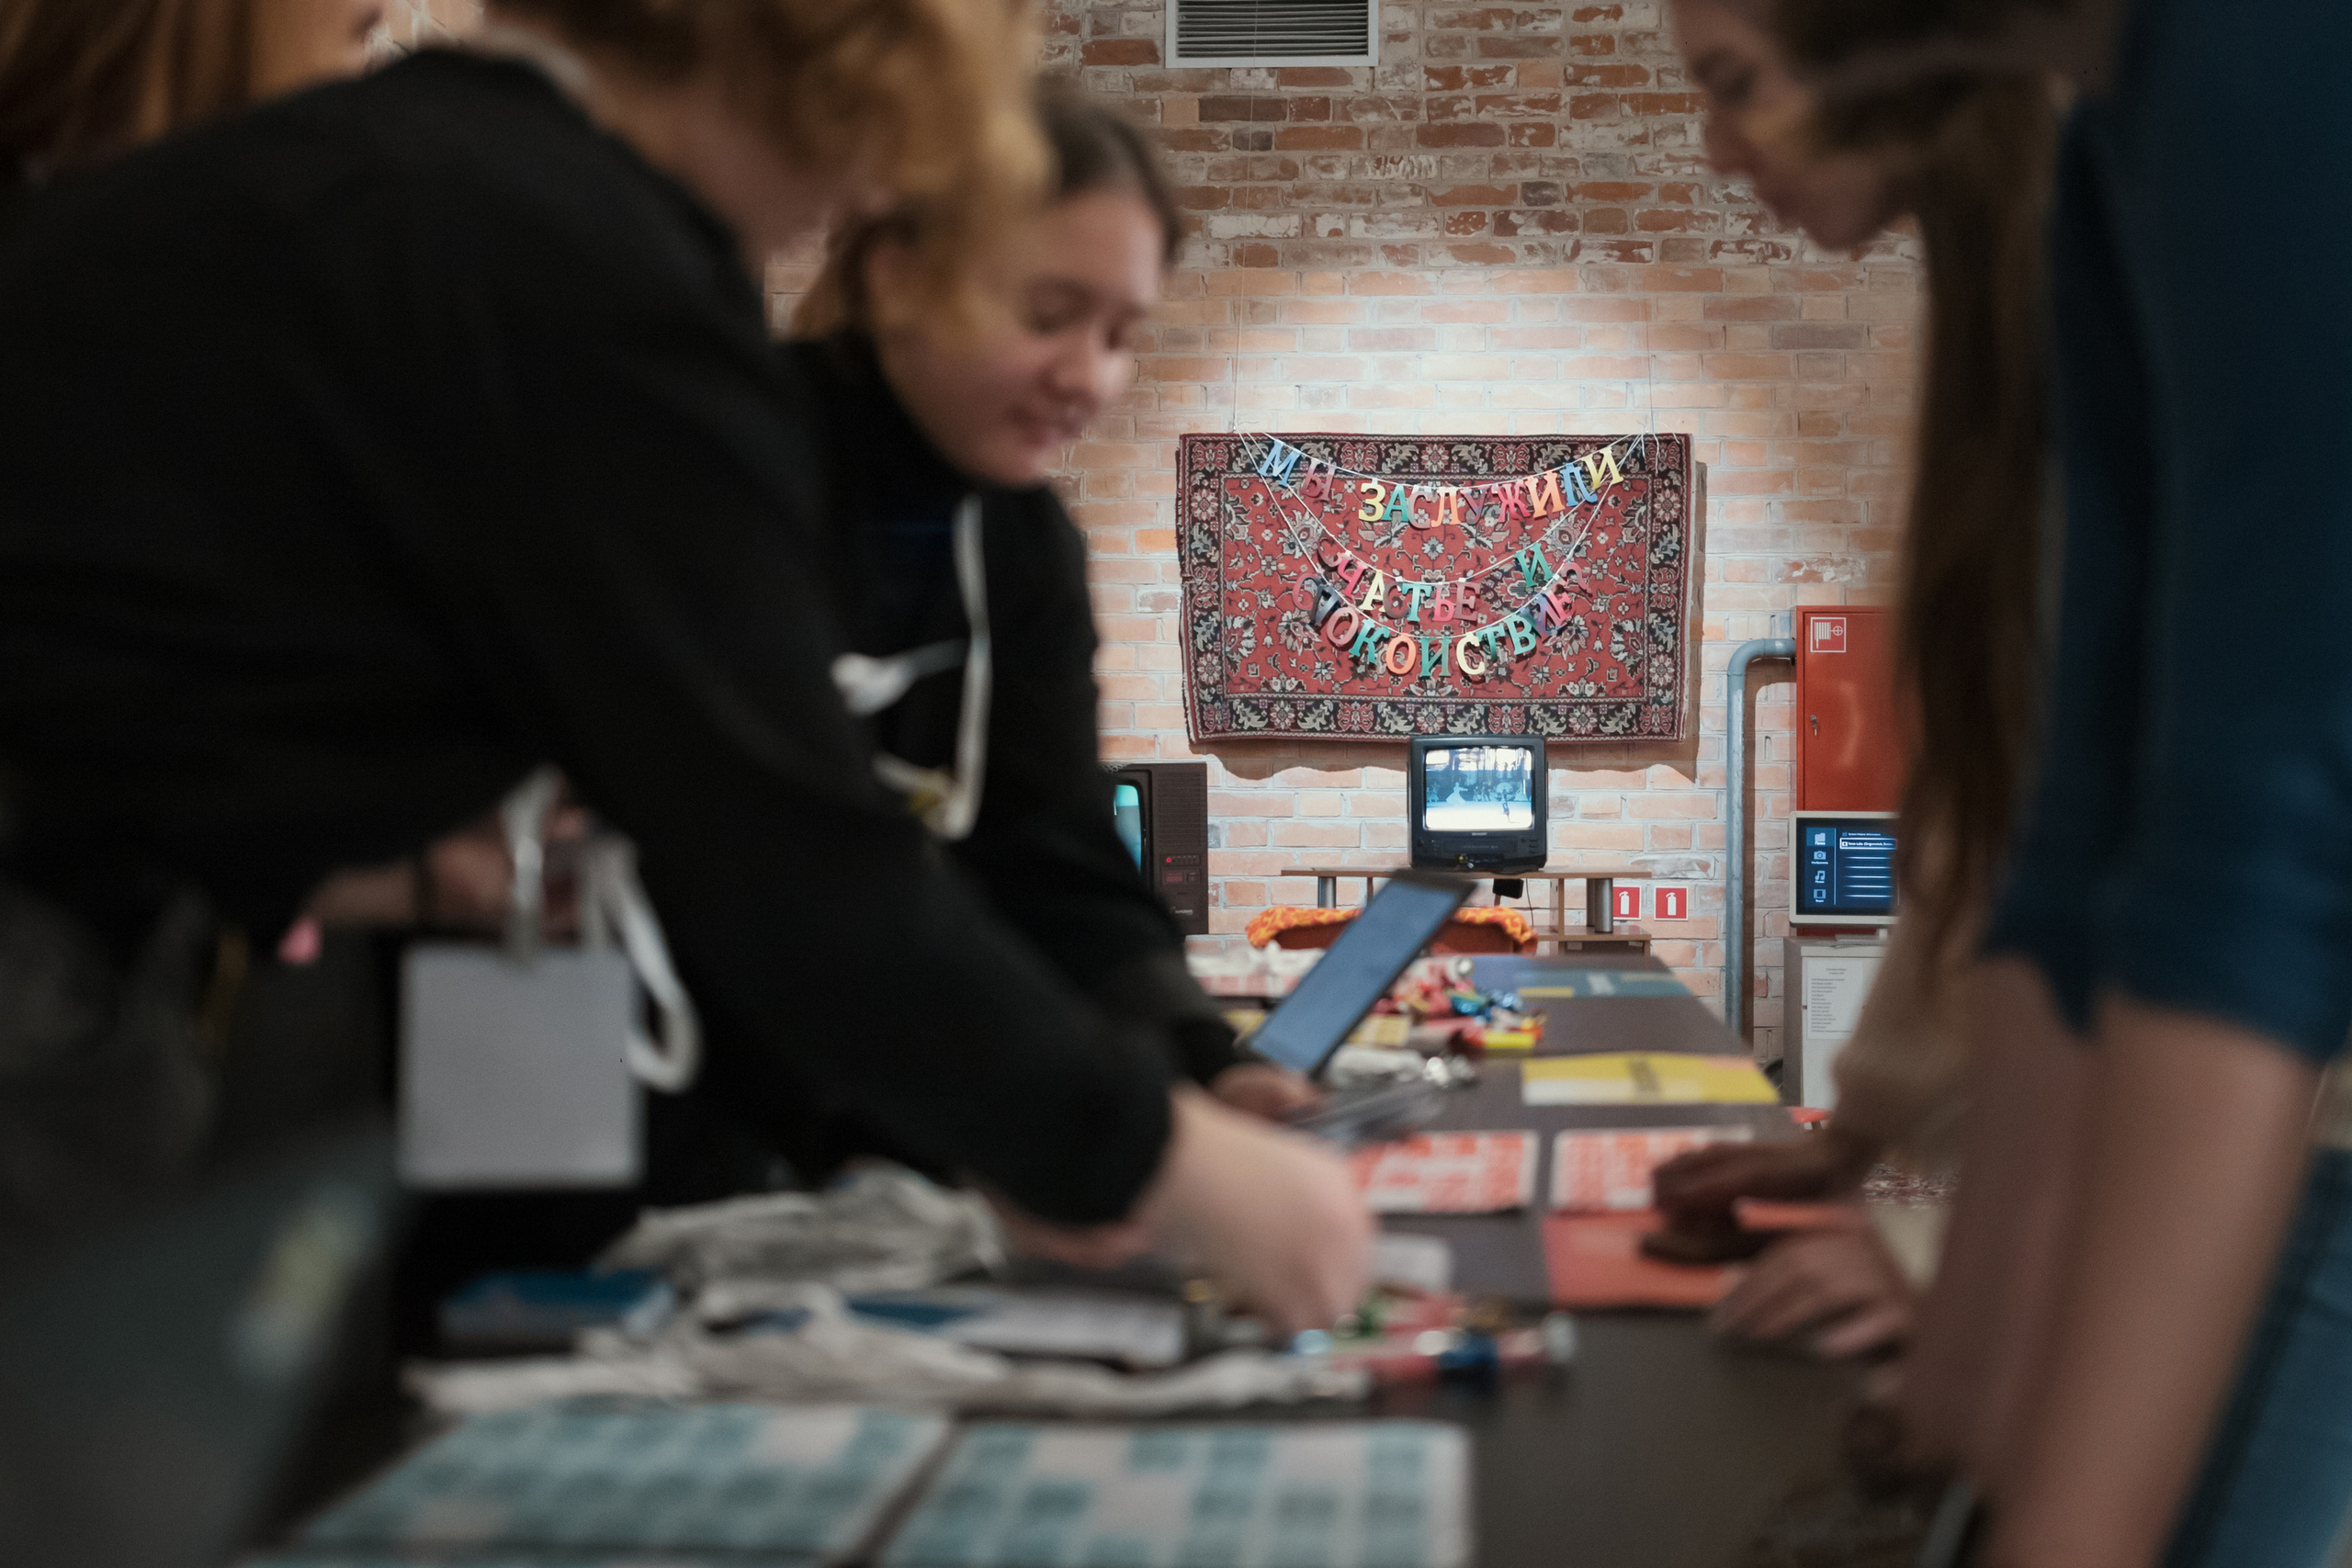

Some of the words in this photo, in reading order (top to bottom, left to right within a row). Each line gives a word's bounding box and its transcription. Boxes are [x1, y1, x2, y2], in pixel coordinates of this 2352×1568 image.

[1258, 440, 1337, 502] МЫ
[1358, 446, 1624, 529] ЗАСЛУЖИЛИ
[1317, 537, 1480, 623] СЧАСТЬЕ
[1514, 542, 1554, 588] И
